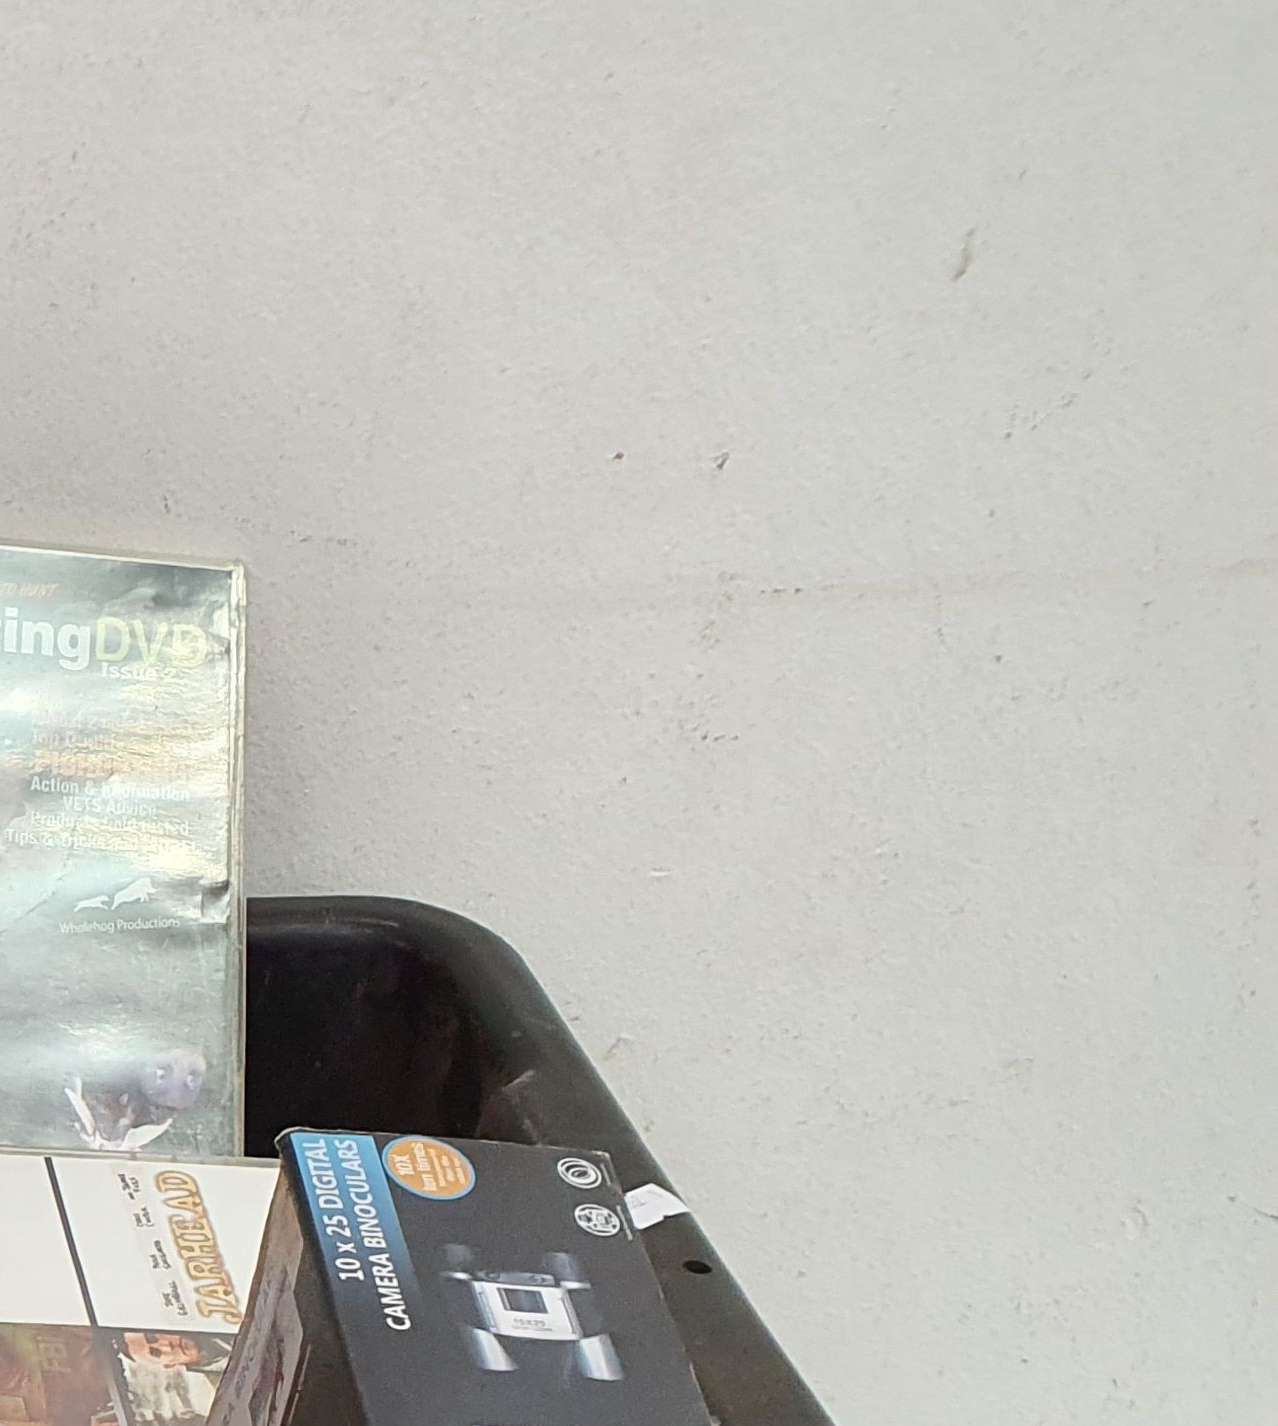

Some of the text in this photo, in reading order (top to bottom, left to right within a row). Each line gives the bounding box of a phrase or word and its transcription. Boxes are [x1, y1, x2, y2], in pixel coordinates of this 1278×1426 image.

[94, 616, 208, 668] DVD
[30, 775, 80, 795] Action
[5, 828, 38, 847] Tips
[116, 917, 182, 932] Productions
[390, 1154, 414, 1176] 10X
[302, 1138, 365, 1282] 10 x 25 DIGITAL
[154, 1170, 244, 1325] JARHEAD
[334, 1138, 412, 1331] CAMERA BINOCULARS
